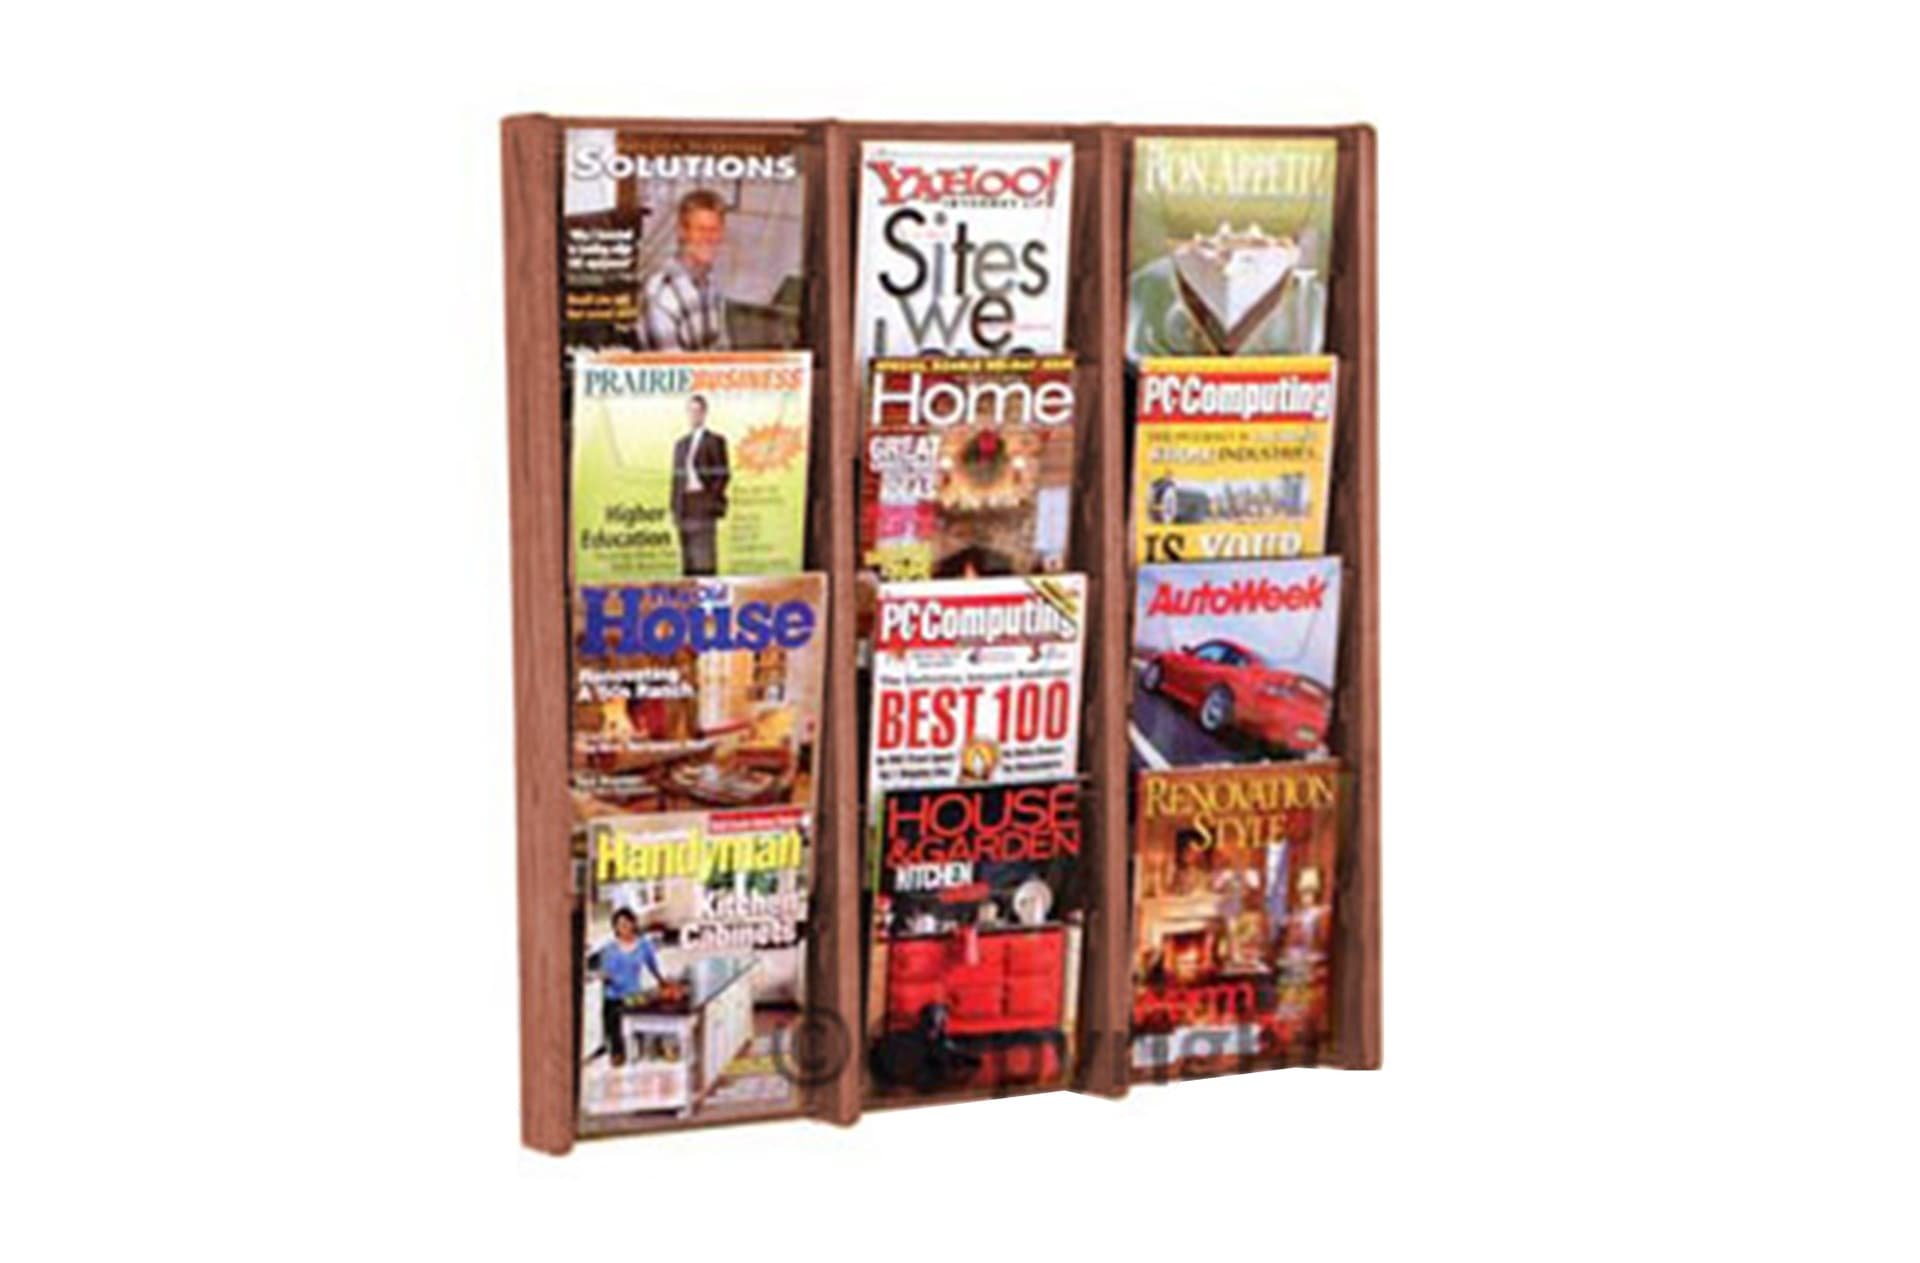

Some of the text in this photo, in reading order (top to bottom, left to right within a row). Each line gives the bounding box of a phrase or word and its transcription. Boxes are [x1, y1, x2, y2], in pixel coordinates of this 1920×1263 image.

[573, 147, 796, 179] SOLUTIONS
[866, 157, 1063, 206] YAHOO!
[878, 207, 1050, 299] Sites
[871, 372, 1075, 426] Home
[606, 503, 667, 528] Higher
[581, 527, 672, 551] Education
[1147, 573, 1328, 617] AutoWeek
[580, 585, 816, 655] House
[877, 678, 1071, 750] BEST 100
[887, 784, 1080, 838] HOUSE
[1145, 774, 1336, 818] RENOVATION
[1192, 809, 1289, 850] STYLE
[598, 828, 802, 883] Handyman
[702, 890, 801, 920] Kitchen
[680, 920, 798, 951] Cabinets
